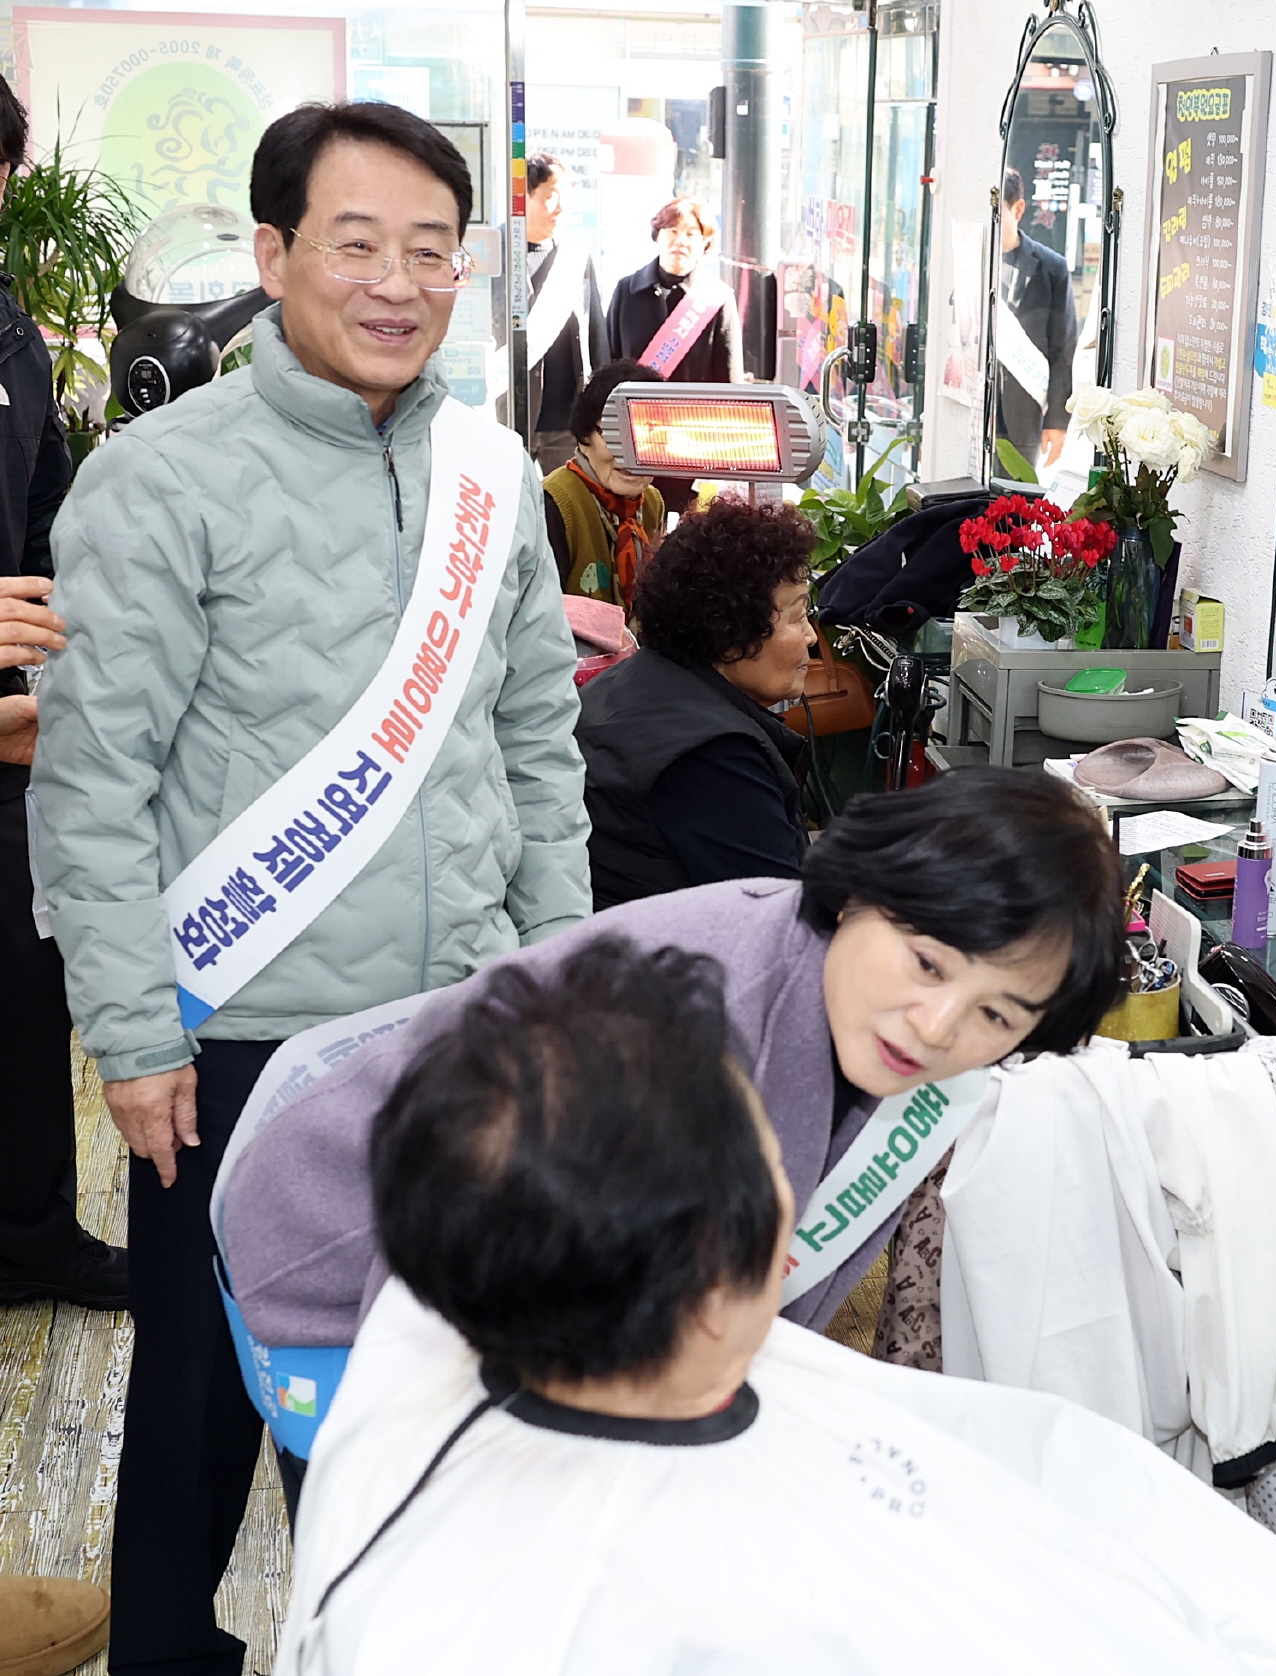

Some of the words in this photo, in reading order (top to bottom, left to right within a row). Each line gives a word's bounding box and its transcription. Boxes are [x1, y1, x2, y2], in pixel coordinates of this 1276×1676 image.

[371, 609, 460, 763] 이용으로
[252, 750, 393, 893] 지역경제
[173, 866, 280, 971] 활성화
